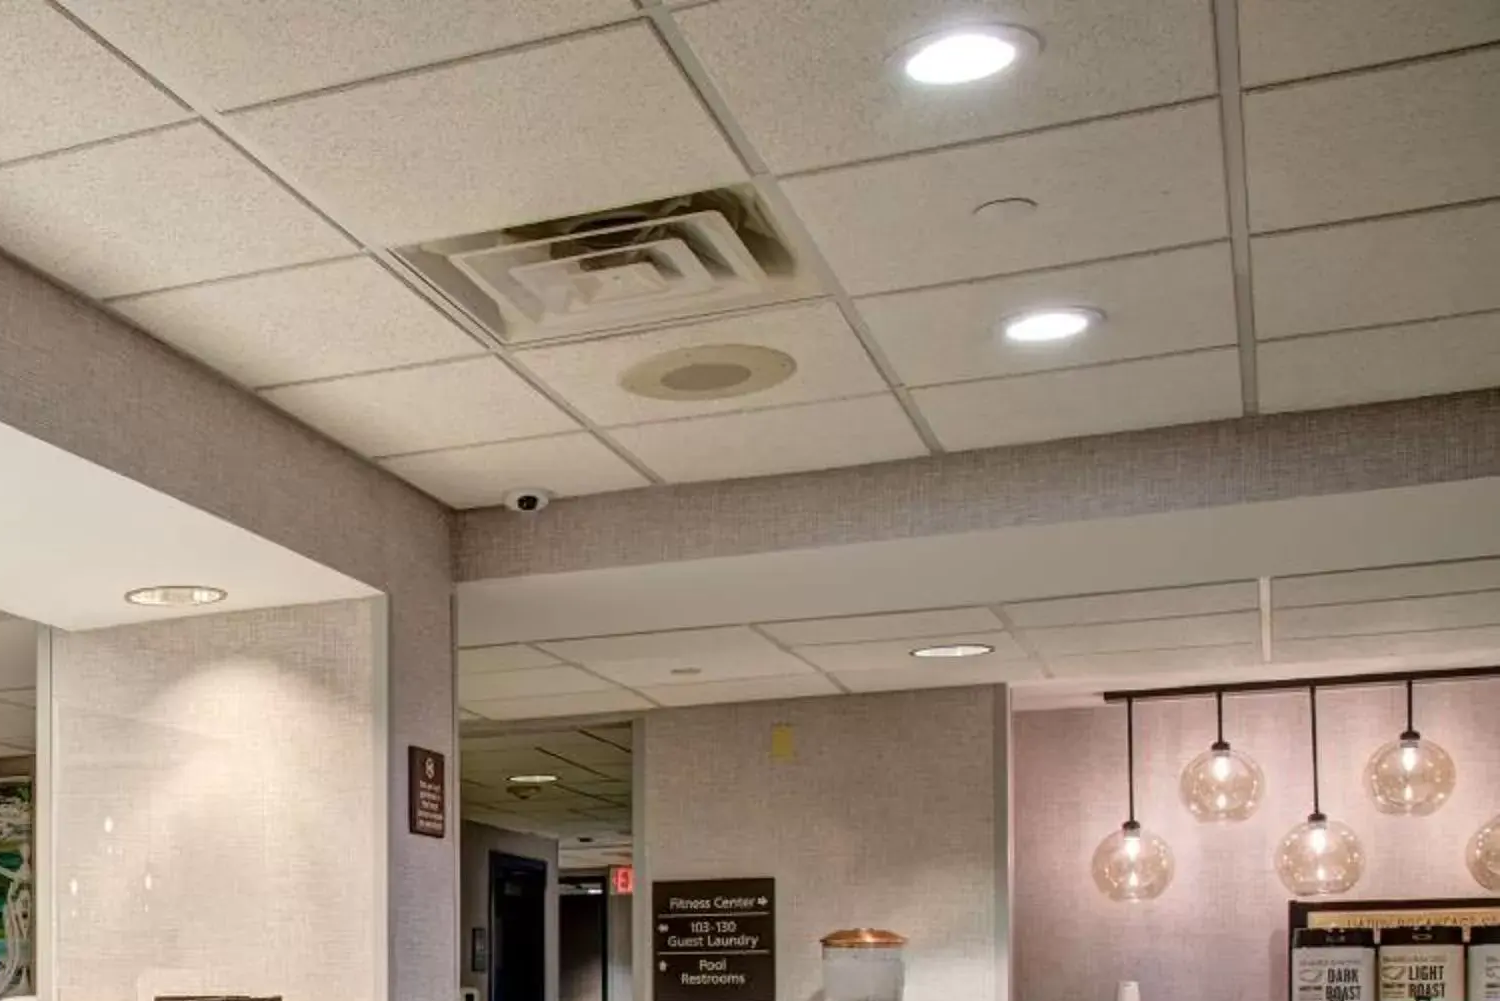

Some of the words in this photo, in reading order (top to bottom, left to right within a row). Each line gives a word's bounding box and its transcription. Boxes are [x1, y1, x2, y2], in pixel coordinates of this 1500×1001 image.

[669, 897, 712, 910] Fitness
[713, 896, 755, 909] Center
[667, 935, 704, 947] Guest
[707, 934, 759, 949] Laundry
[699, 959, 727, 972] Pool
[1408, 965, 1444, 981] LIGHT
[681, 972, 746, 985] Restrooms
[1327, 968, 1359, 983] DARK
[1325, 985, 1361, 1001] ROAST
[1408, 982, 1446, 999] ROAST
